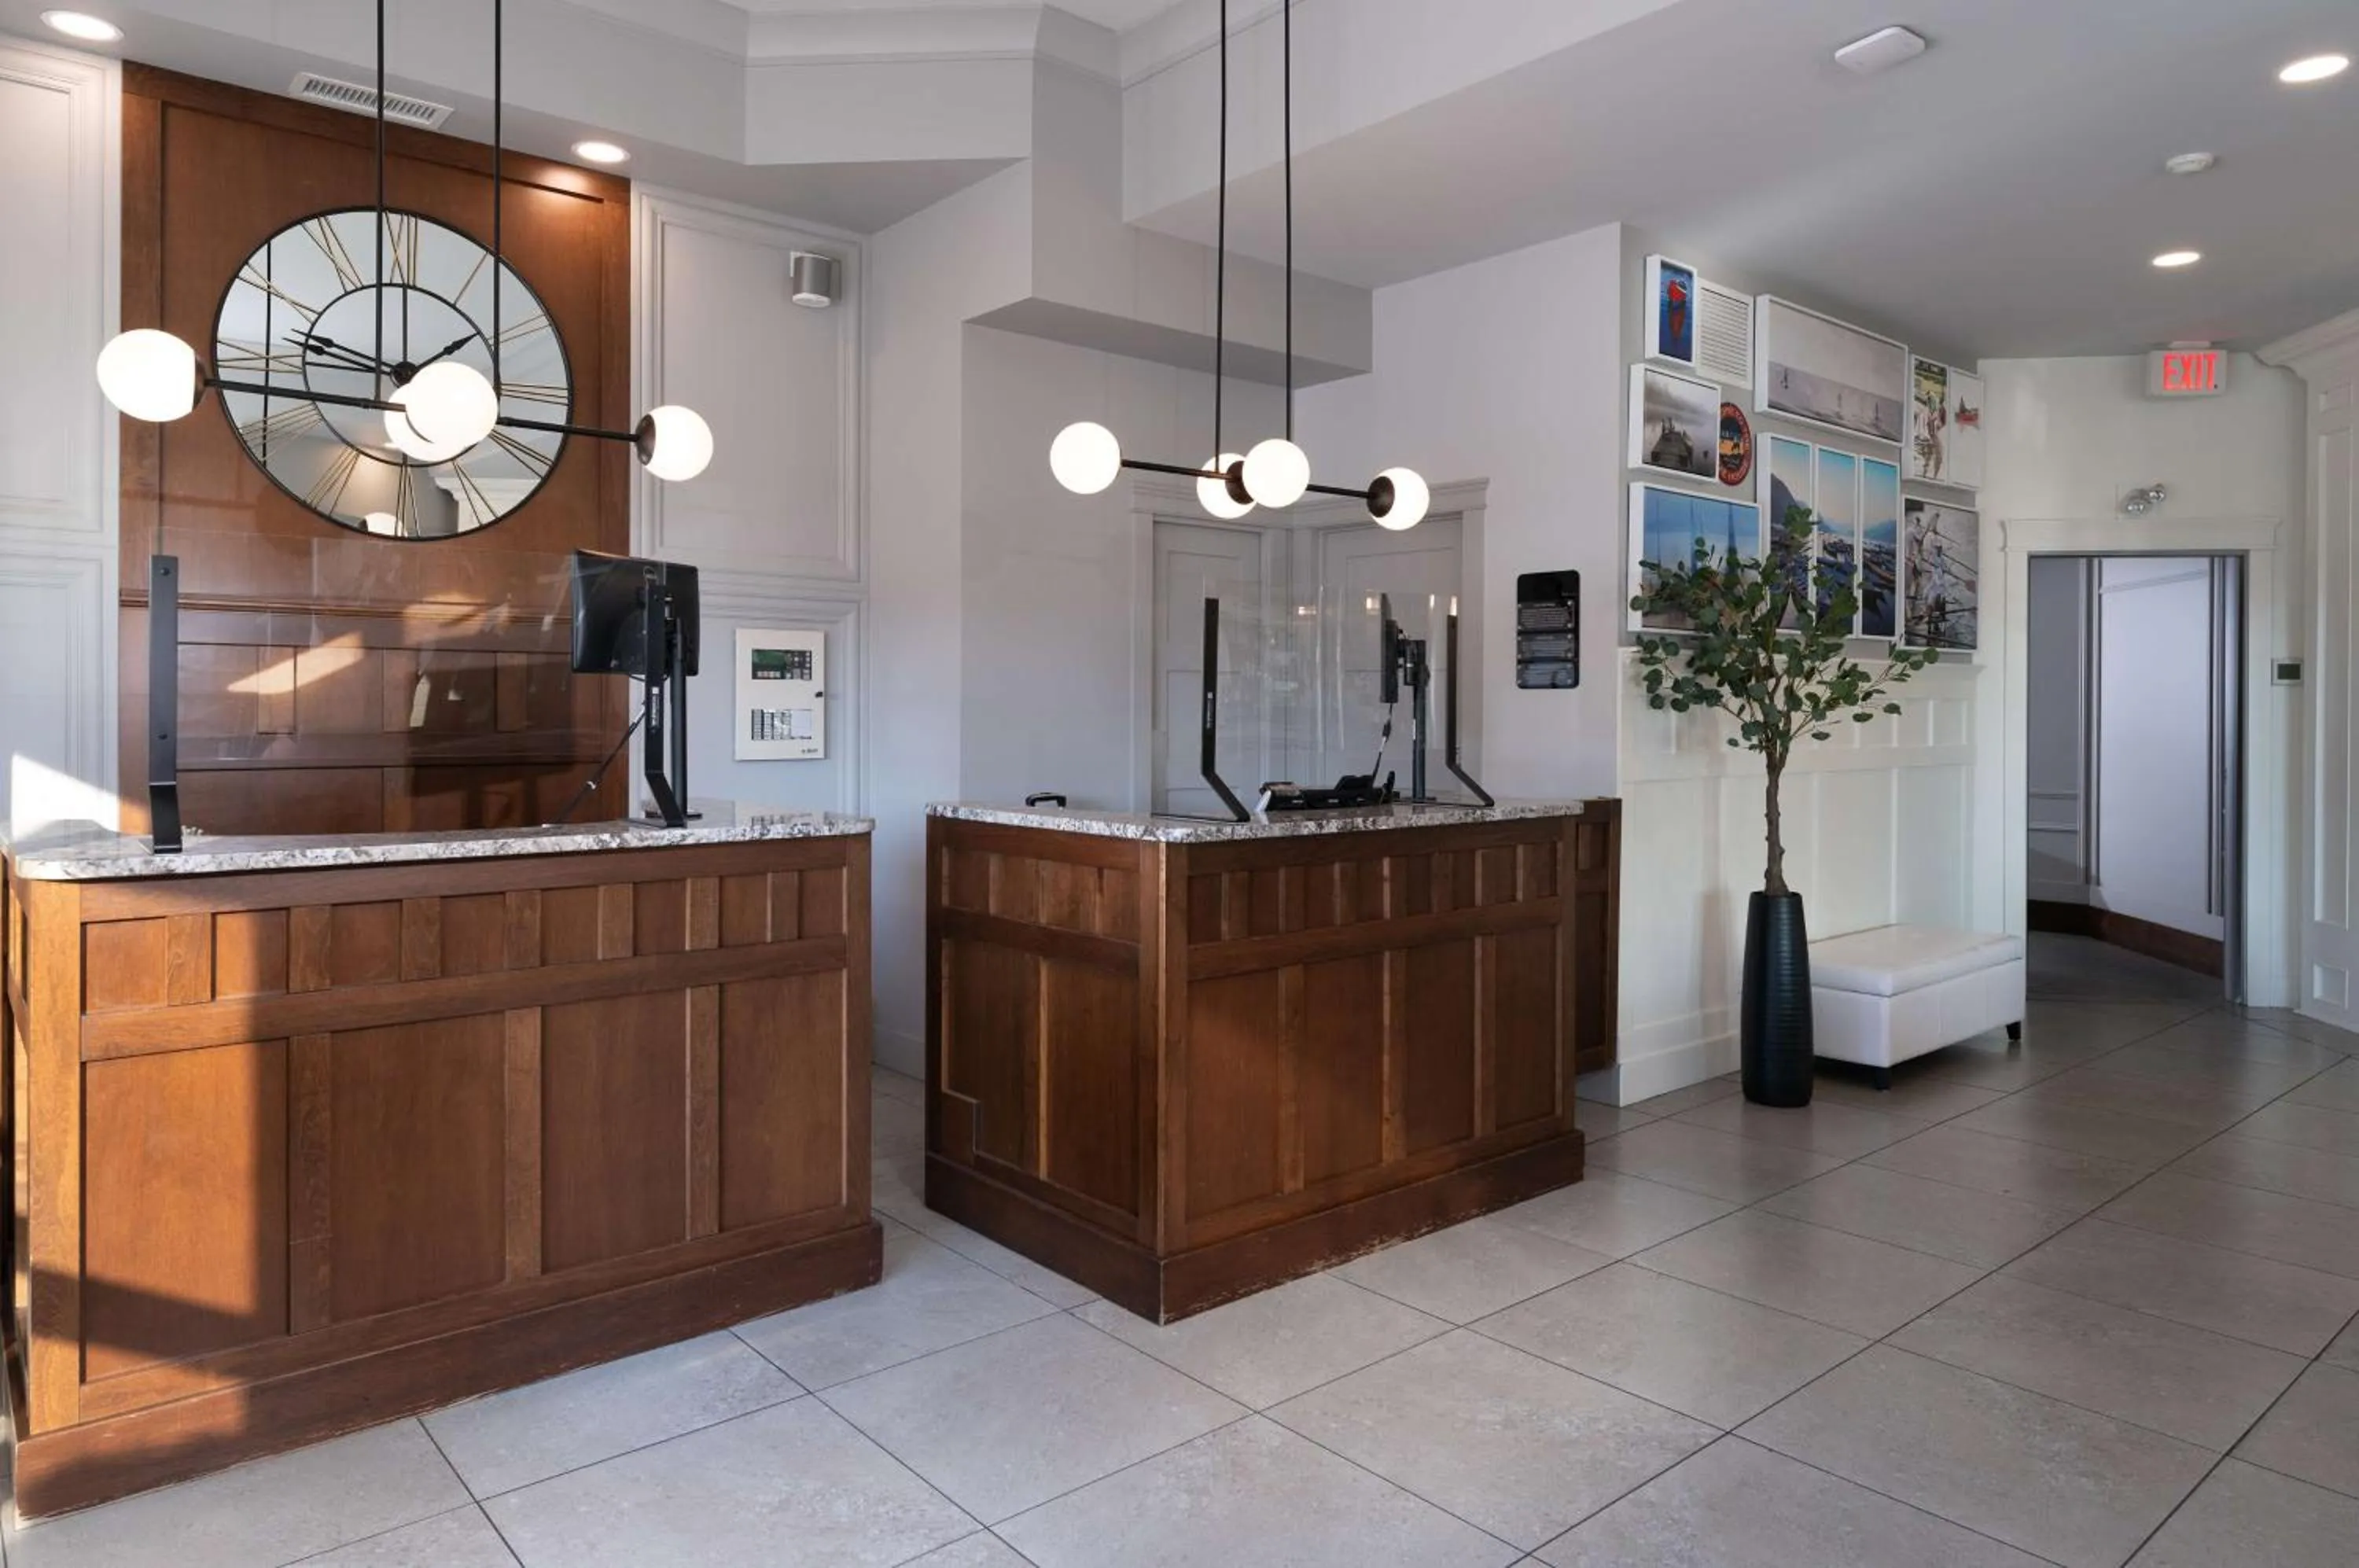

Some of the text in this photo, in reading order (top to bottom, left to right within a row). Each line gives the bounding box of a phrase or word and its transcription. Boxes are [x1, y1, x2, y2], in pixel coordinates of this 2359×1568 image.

[301, 216, 364, 293] XI
[385, 211, 418, 287] XII
[237, 261, 321, 326] X
[2163, 353, 2216, 393] EXIT
